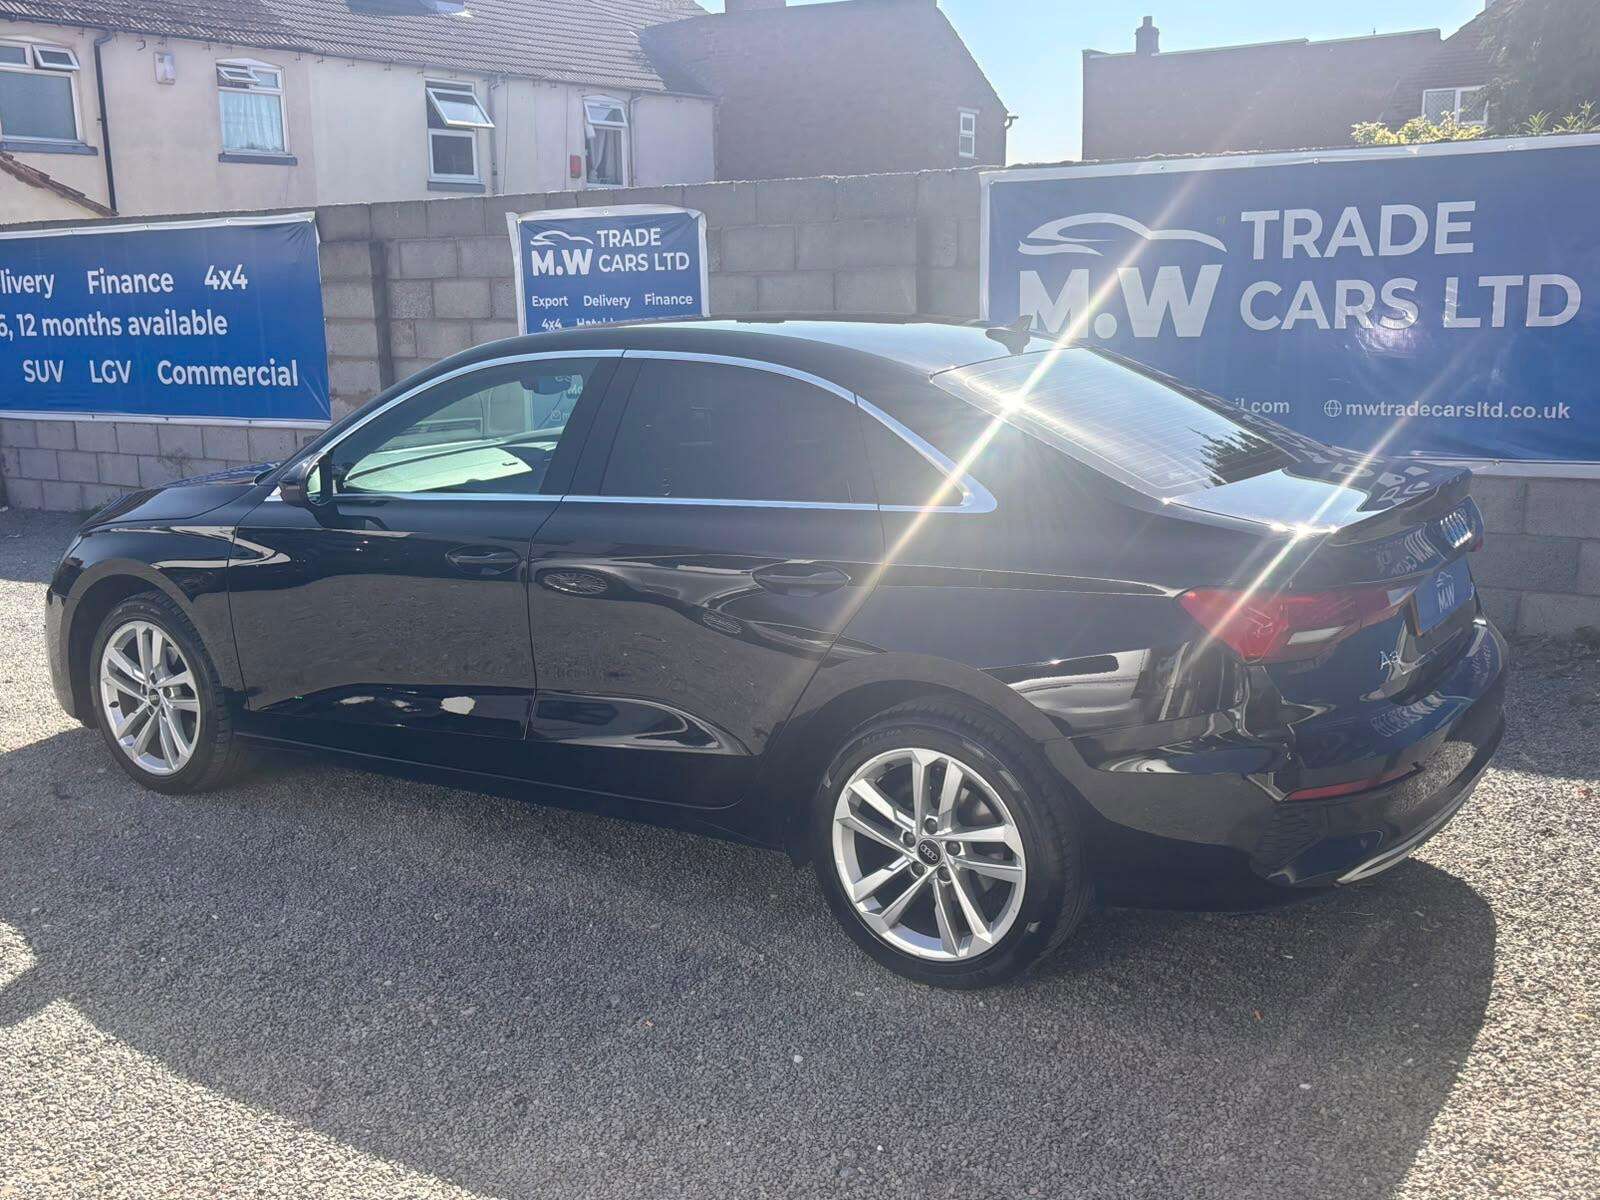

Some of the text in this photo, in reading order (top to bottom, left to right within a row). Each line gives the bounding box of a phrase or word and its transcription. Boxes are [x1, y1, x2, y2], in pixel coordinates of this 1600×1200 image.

[596, 228, 662, 248] TRADE
[1241, 200, 1476, 259] TRADE
[531, 248, 593, 276] M.W
[599, 252, 690, 272] CARS LTD
[0, 264, 248, 299] livery Finance 4x4
[532, 293, 693, 309] Export Delivery Finance
[1020, 264, 1223, 338] M.W
[1239, 273, 1581, 331] CARS LTD
[16, 313, 37, 337] 12
[42, 310, 122, 337] months
[128, 308, 228, 337] available
[23, 358, 298, 387] SUV LGV Commercial
[1346, 401, 1570, 419] mwtradecarsltd.co.uk
